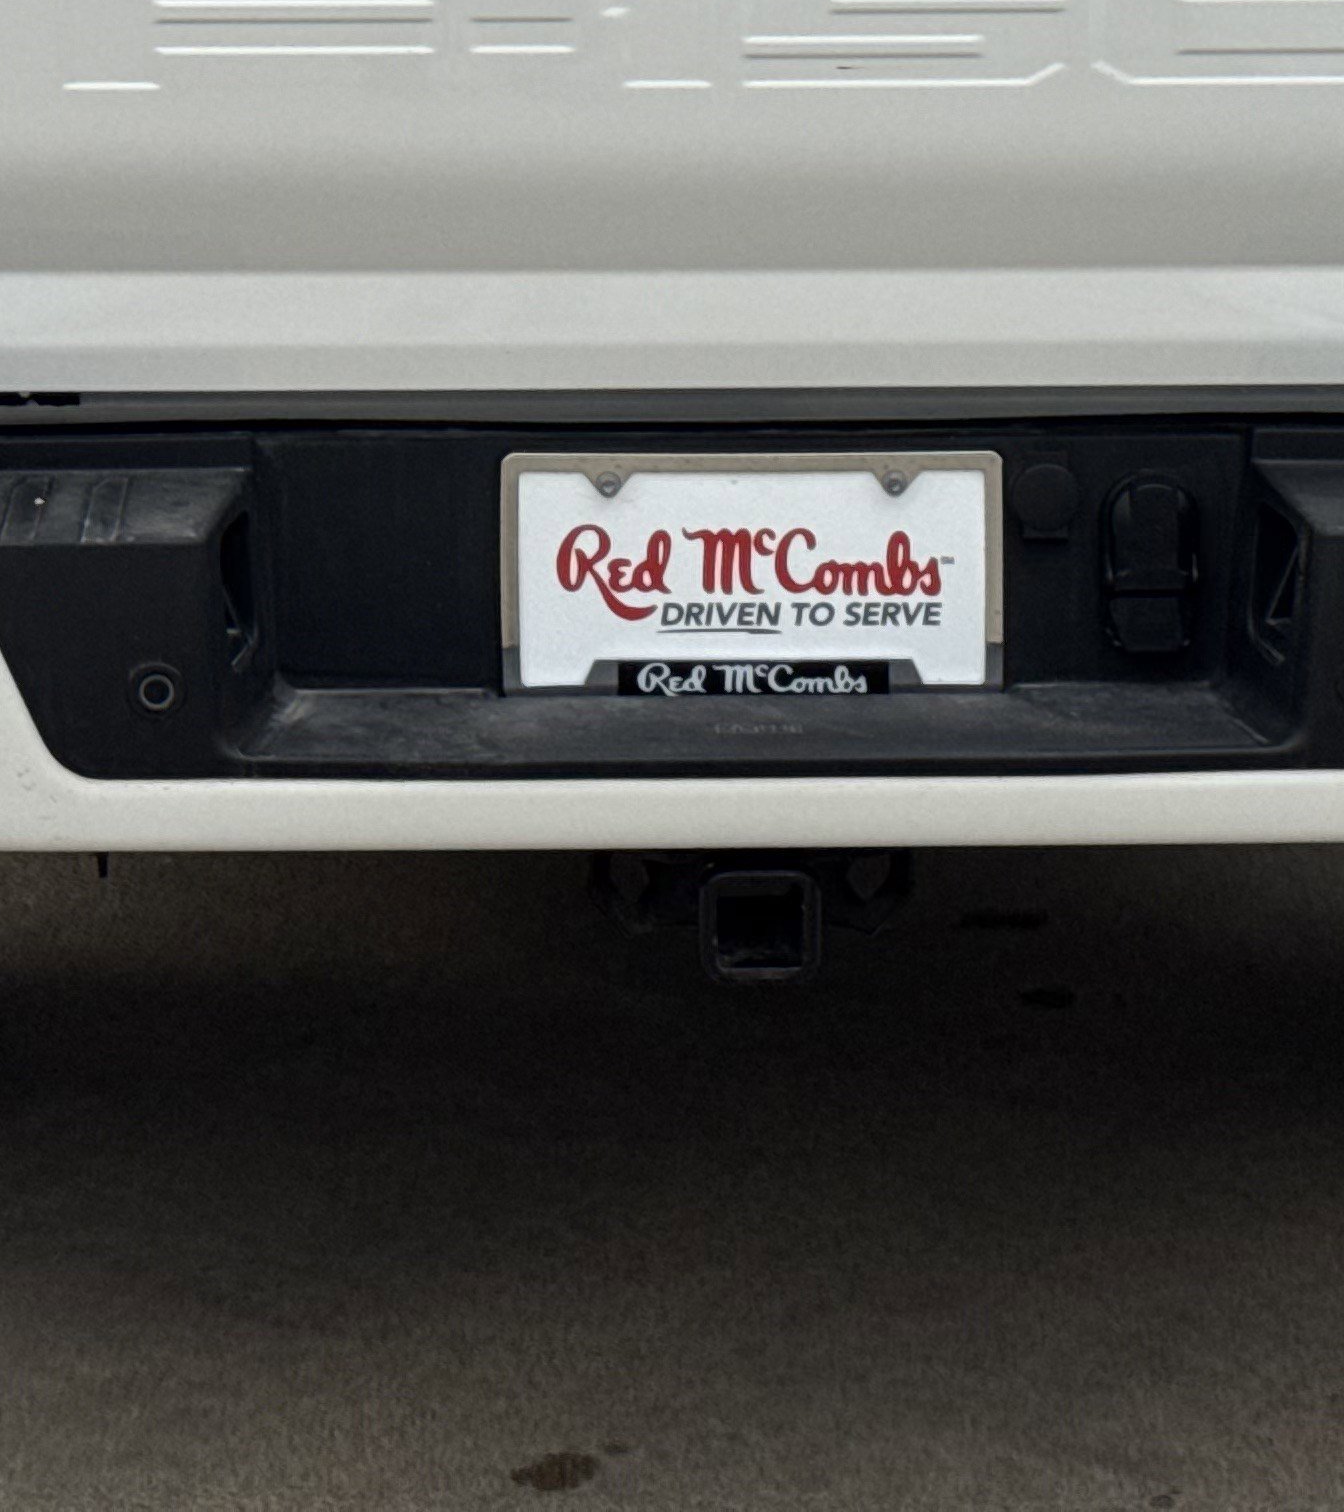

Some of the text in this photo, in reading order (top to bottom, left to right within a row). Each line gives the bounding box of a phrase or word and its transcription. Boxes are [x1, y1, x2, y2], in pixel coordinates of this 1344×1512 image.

[557, 524, 942, 622] Red McCombs
[660, 601, 943, 627] DRIVEN TO SERVE
[637, 662, 869, 697] Red McCombs
